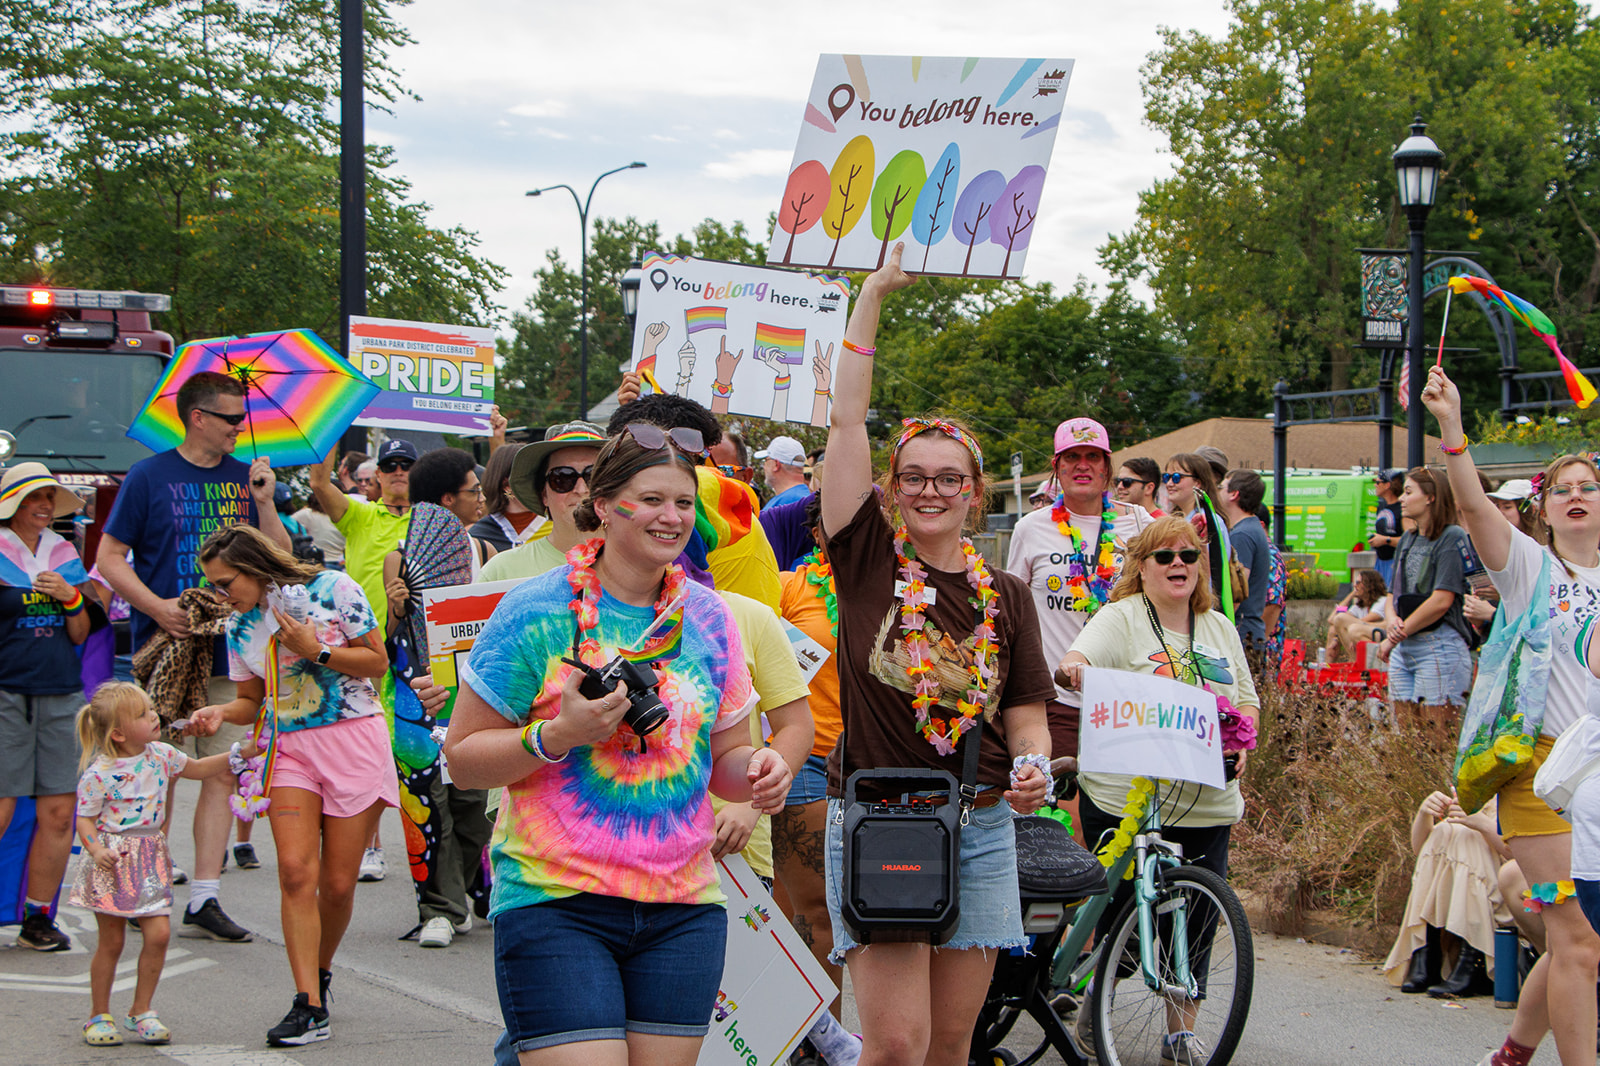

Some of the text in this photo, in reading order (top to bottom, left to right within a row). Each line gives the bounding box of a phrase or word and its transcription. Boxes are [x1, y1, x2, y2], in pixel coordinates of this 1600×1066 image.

[860, 96, 1040, 129] You belong here.
[672, 276, 814, 309] You belong here.
[1366, 320, 1402, 336] URBANA
[362, 338, 474, 355] URBANA PARK DISTRICT CELEBRATES
[361, 351, 484, 398] PRIDE
[415, 399, 472, 411] YOU BELONG HERE!
[59, 474, 111, 486] DEPT.
[168, 482, 250, 501] YOU KNOW
[171, 500, 250, 516] WHAT I WANT
[175, 534, 211, 552] WHE
[176, 553, 205, 575] GR
[26, 604, 62, 615] ONLY
[34, 627, 54, 638] DO
[450, 622, 485, 639] URBA
